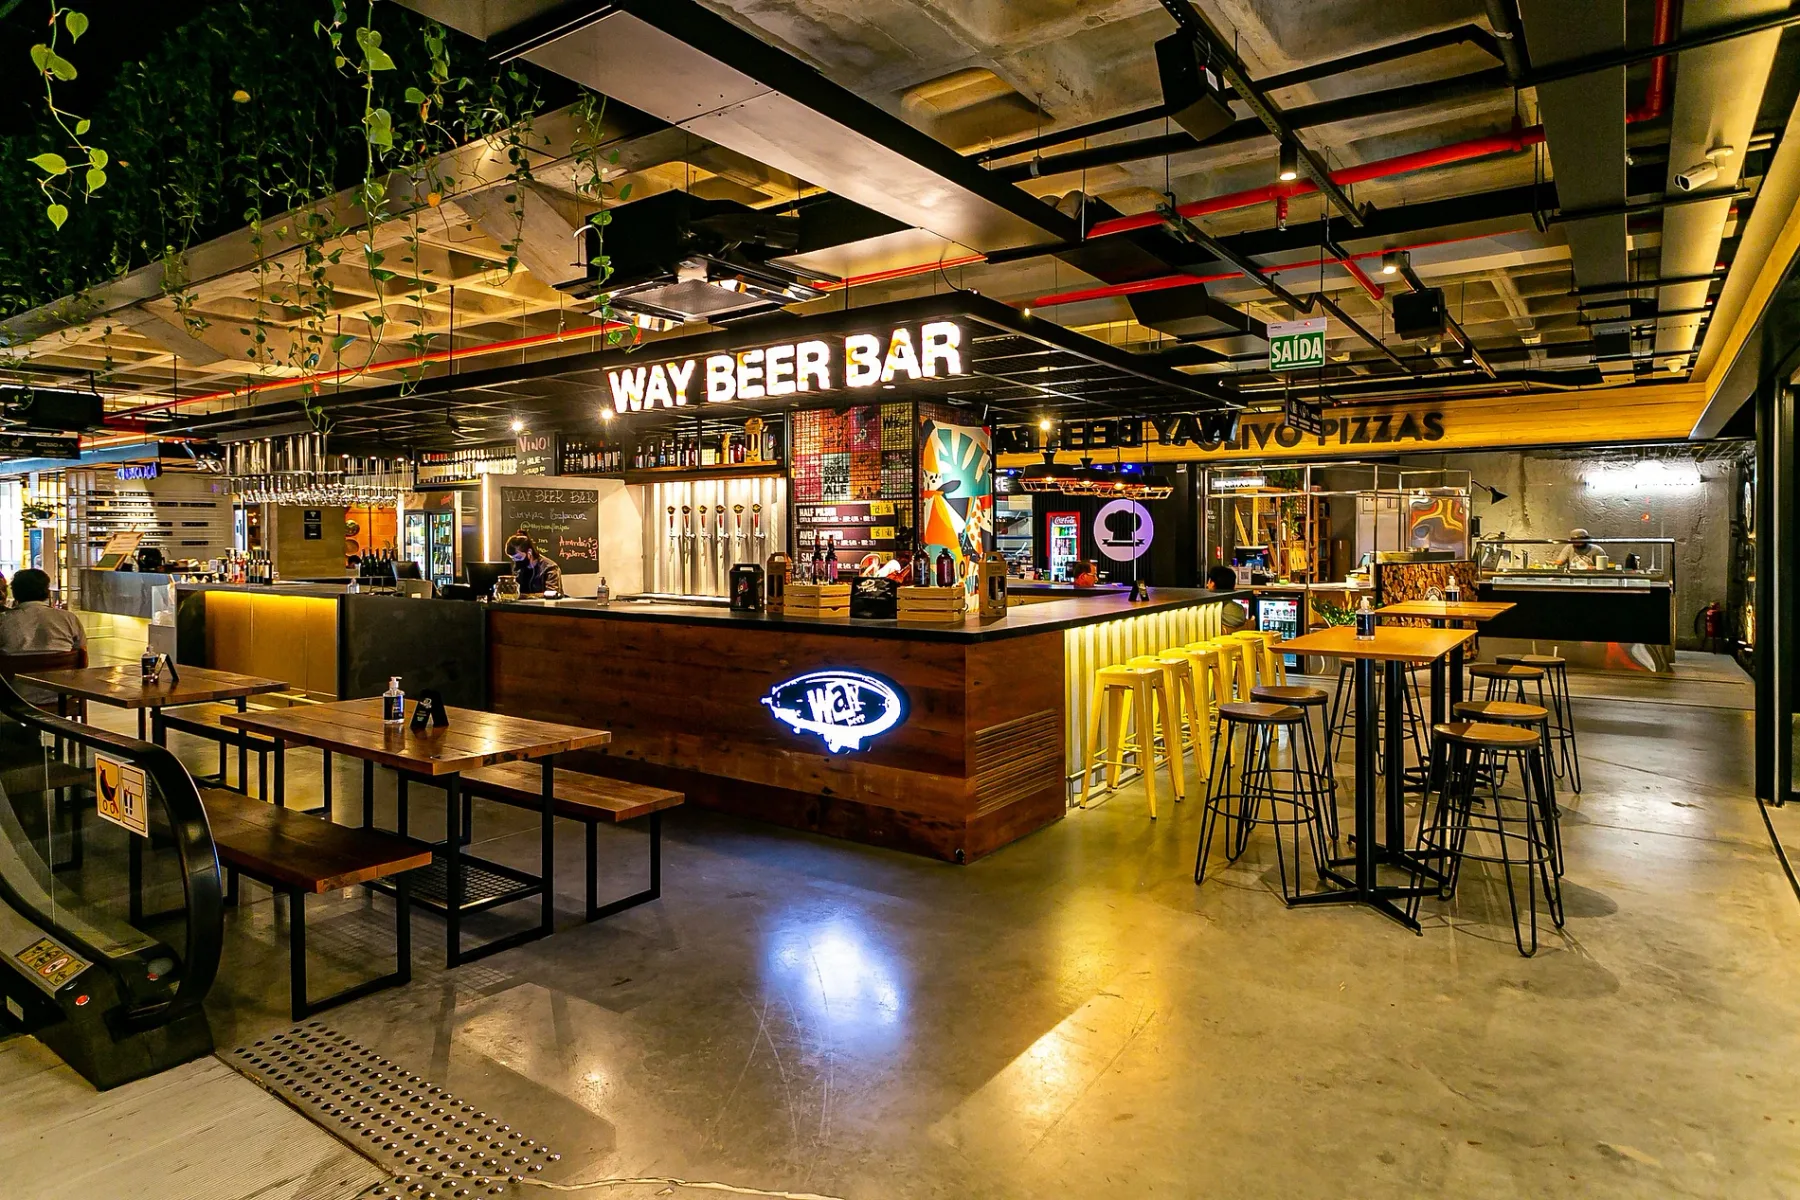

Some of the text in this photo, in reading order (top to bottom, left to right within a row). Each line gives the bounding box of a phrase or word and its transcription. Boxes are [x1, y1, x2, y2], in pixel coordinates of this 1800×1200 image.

[1271, 335, 1323, 364] SAÍDA
[606, 321, 963, 414] WAY BEER BAR
[1318, 412, 1445, 446] PIZZAS
[534, 490, 566, 503] BEER
[569, 490, 598, 504] BAR
[824, 485, 847, 494] ALE
